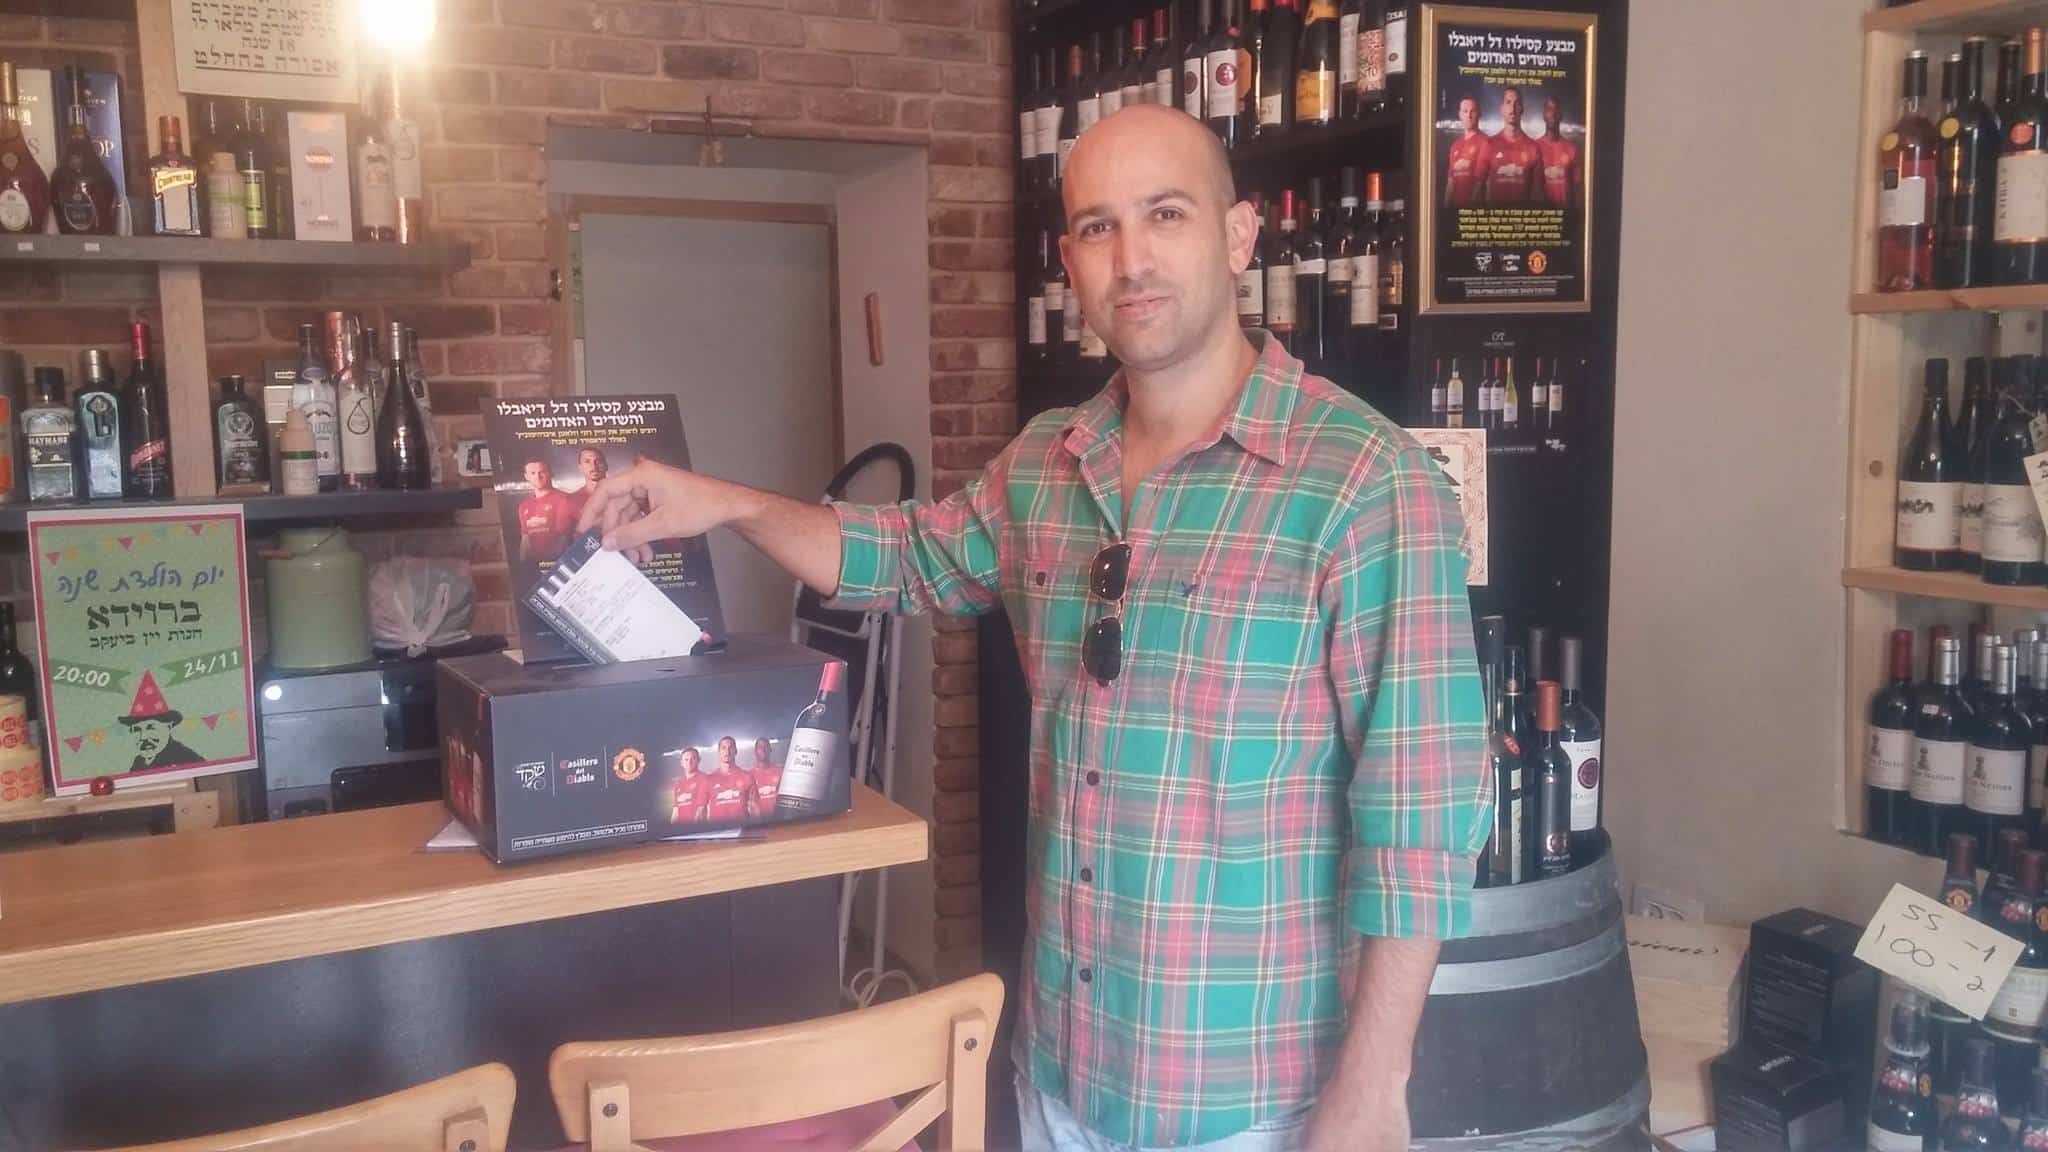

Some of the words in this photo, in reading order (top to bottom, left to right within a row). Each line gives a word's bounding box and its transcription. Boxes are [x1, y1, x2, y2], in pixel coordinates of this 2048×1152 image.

[191, 15, 208, 31] לו
[241, 36, 271, 49] שנה
[1448, 31, 1485, 47] דיאבלו
[1487, 32, 1502, 48] דל
[1546, 39, 1576, 52] מבצע
[194, 43, 265, 68] בהחלט
[1467, 51, 1515, 65] האדומים
[275, 55, 337, 73] אסורה
[496, 402, 545, 416] דיאבלו
[550, 400, 568, 414] דל
[575, 400, 622, 415] קסילרו
[626, 400, 665, 413] מבצע
[525, 415, 588, 429] האדומים
[591, 414, 645, 427] והשדים
[57, 567, 99, 603] שנה
[110, 561, 183, 593] הולדת
[192, 565, 225, 592] יום
[87, 600, 203, 630] ברוידא
[168, 628, 203, 642] חנות
[183, 650, 239, 678] 24/11
[53, 664, 111, 687] 20:00
[1875, 924, 1935, 968] 100
